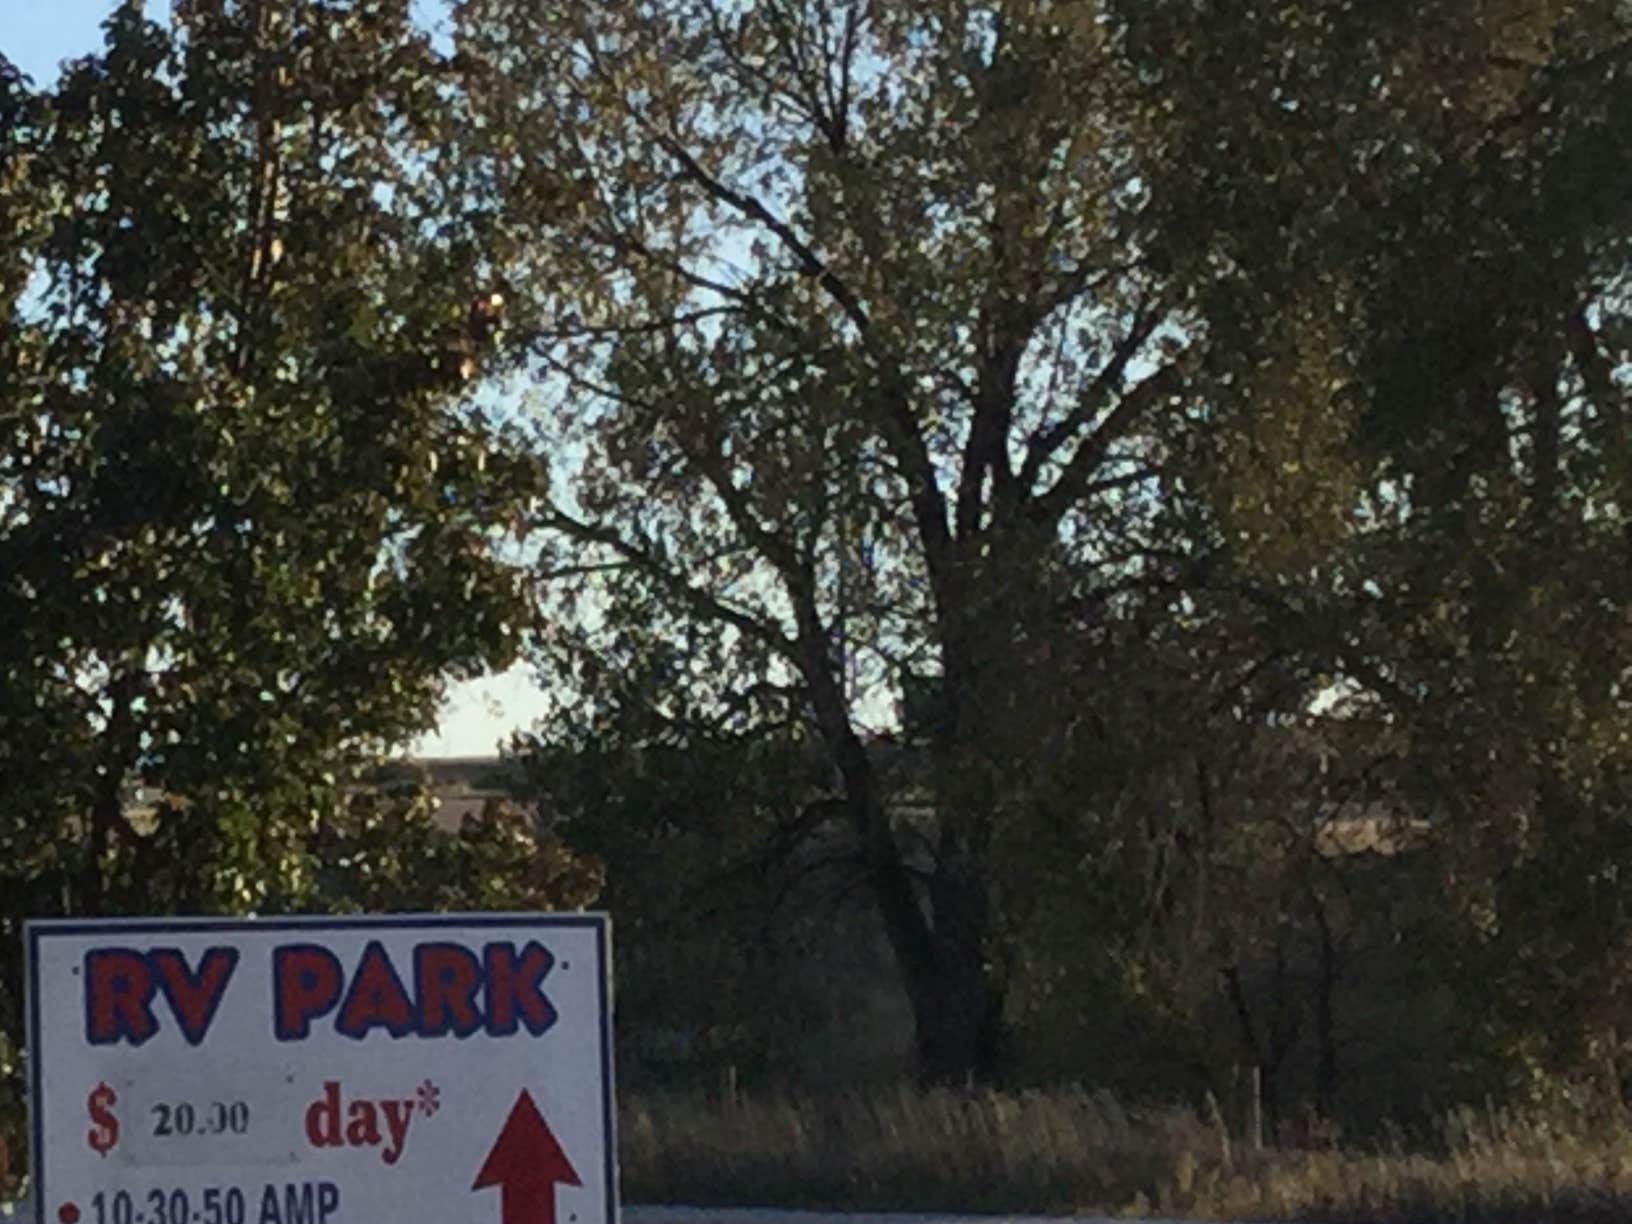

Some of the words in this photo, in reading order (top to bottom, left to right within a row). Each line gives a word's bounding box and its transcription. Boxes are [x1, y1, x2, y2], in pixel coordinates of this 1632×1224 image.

[84, 946, 240, 1047] RV
[272, 940, 558, 1041] PARK
[86, 1080, 121, 1158] $
